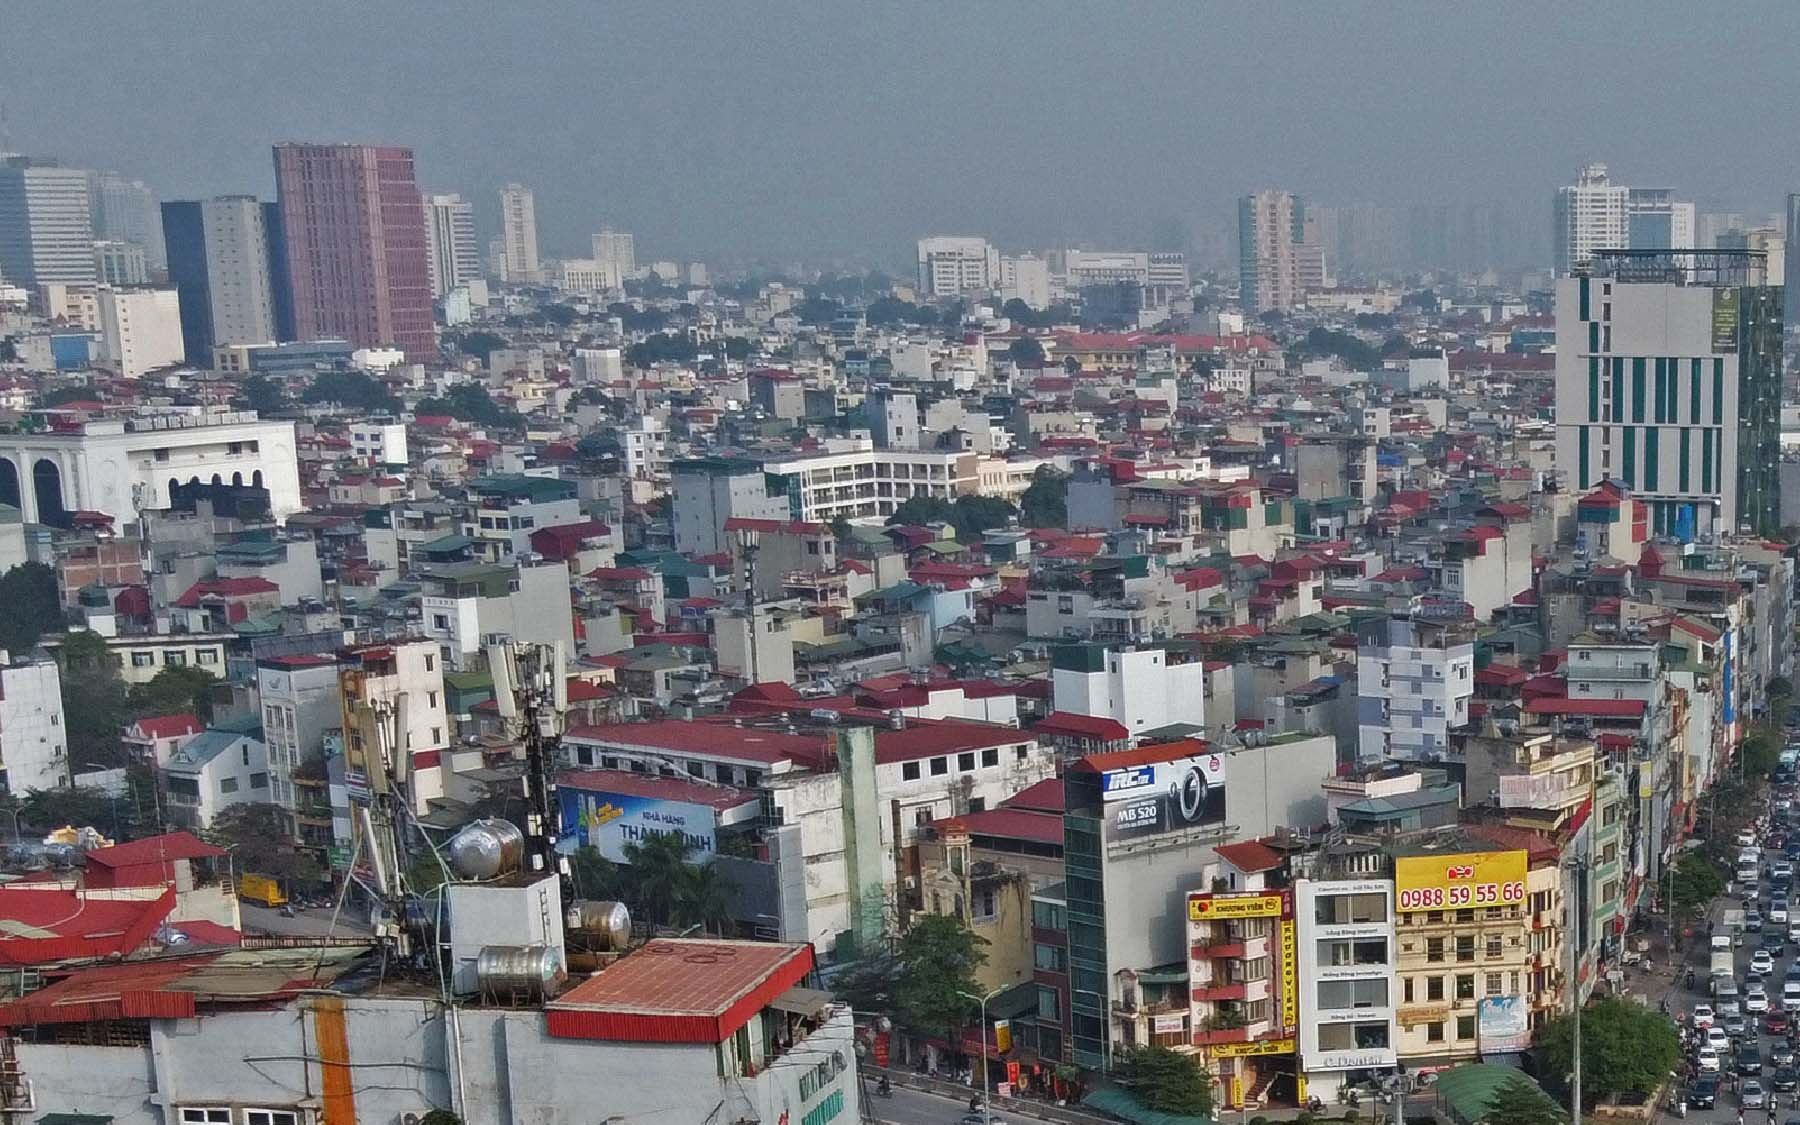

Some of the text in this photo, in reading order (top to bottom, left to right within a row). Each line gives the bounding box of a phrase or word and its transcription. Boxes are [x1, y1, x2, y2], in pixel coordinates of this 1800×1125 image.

[1118, 809, 1137, 822] MB
[1401, 880, 1524, 909] 0988 59 55 66
